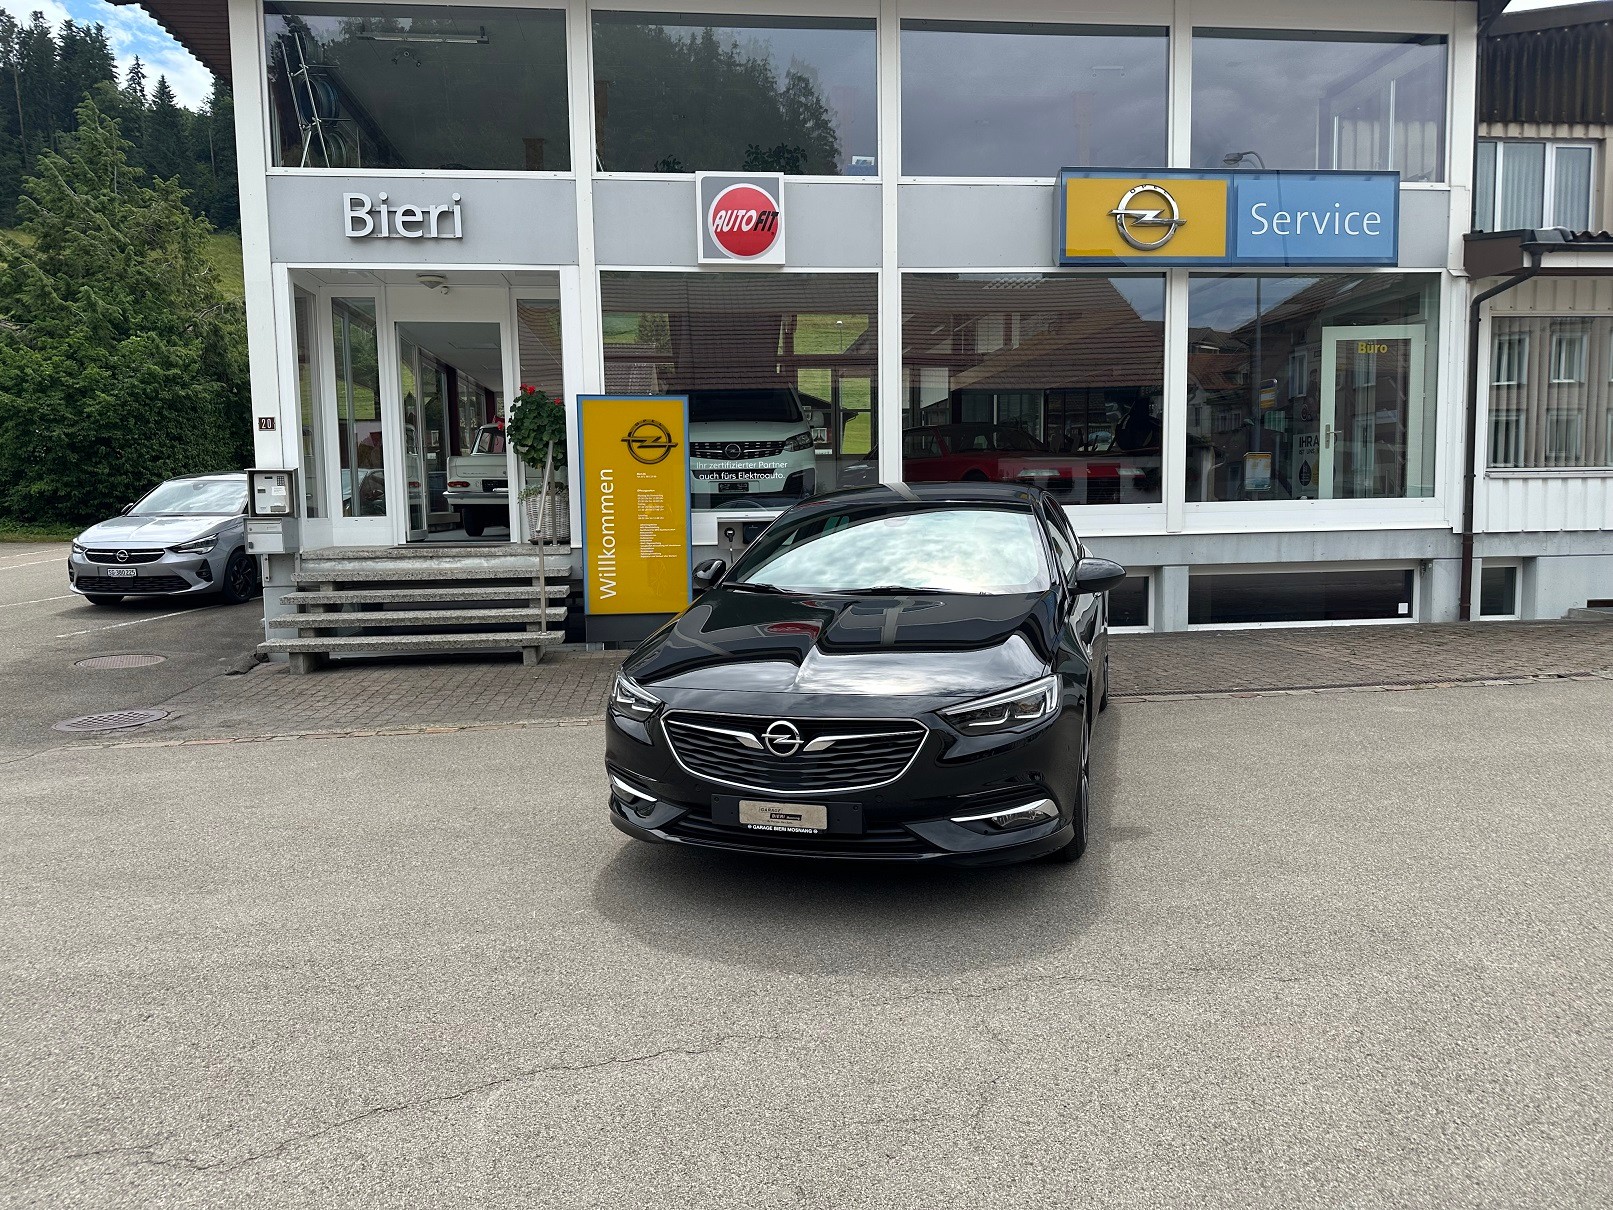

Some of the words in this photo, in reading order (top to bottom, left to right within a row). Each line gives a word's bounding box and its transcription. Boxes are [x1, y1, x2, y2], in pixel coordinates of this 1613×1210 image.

[343, 191, 462, 238] Bieri
[713, 209, 779, 232] AUTOFIT
[1251, 202, 1381, 235] Service
[1358, 342, 1388, 354] Büro
[261, 418, 271, 429] 20
[696, 461, 707, 469] Ihr
[709, 461, 757, 469] zertifizierter
[758, 461, 788, 469] Partner
[699, 472, 719, 480] auch
[721, 471, 737, 480] fürs
[738, 471, 786, 480] Elektroauto.
[598, 469, 617, 599] Willkommen
